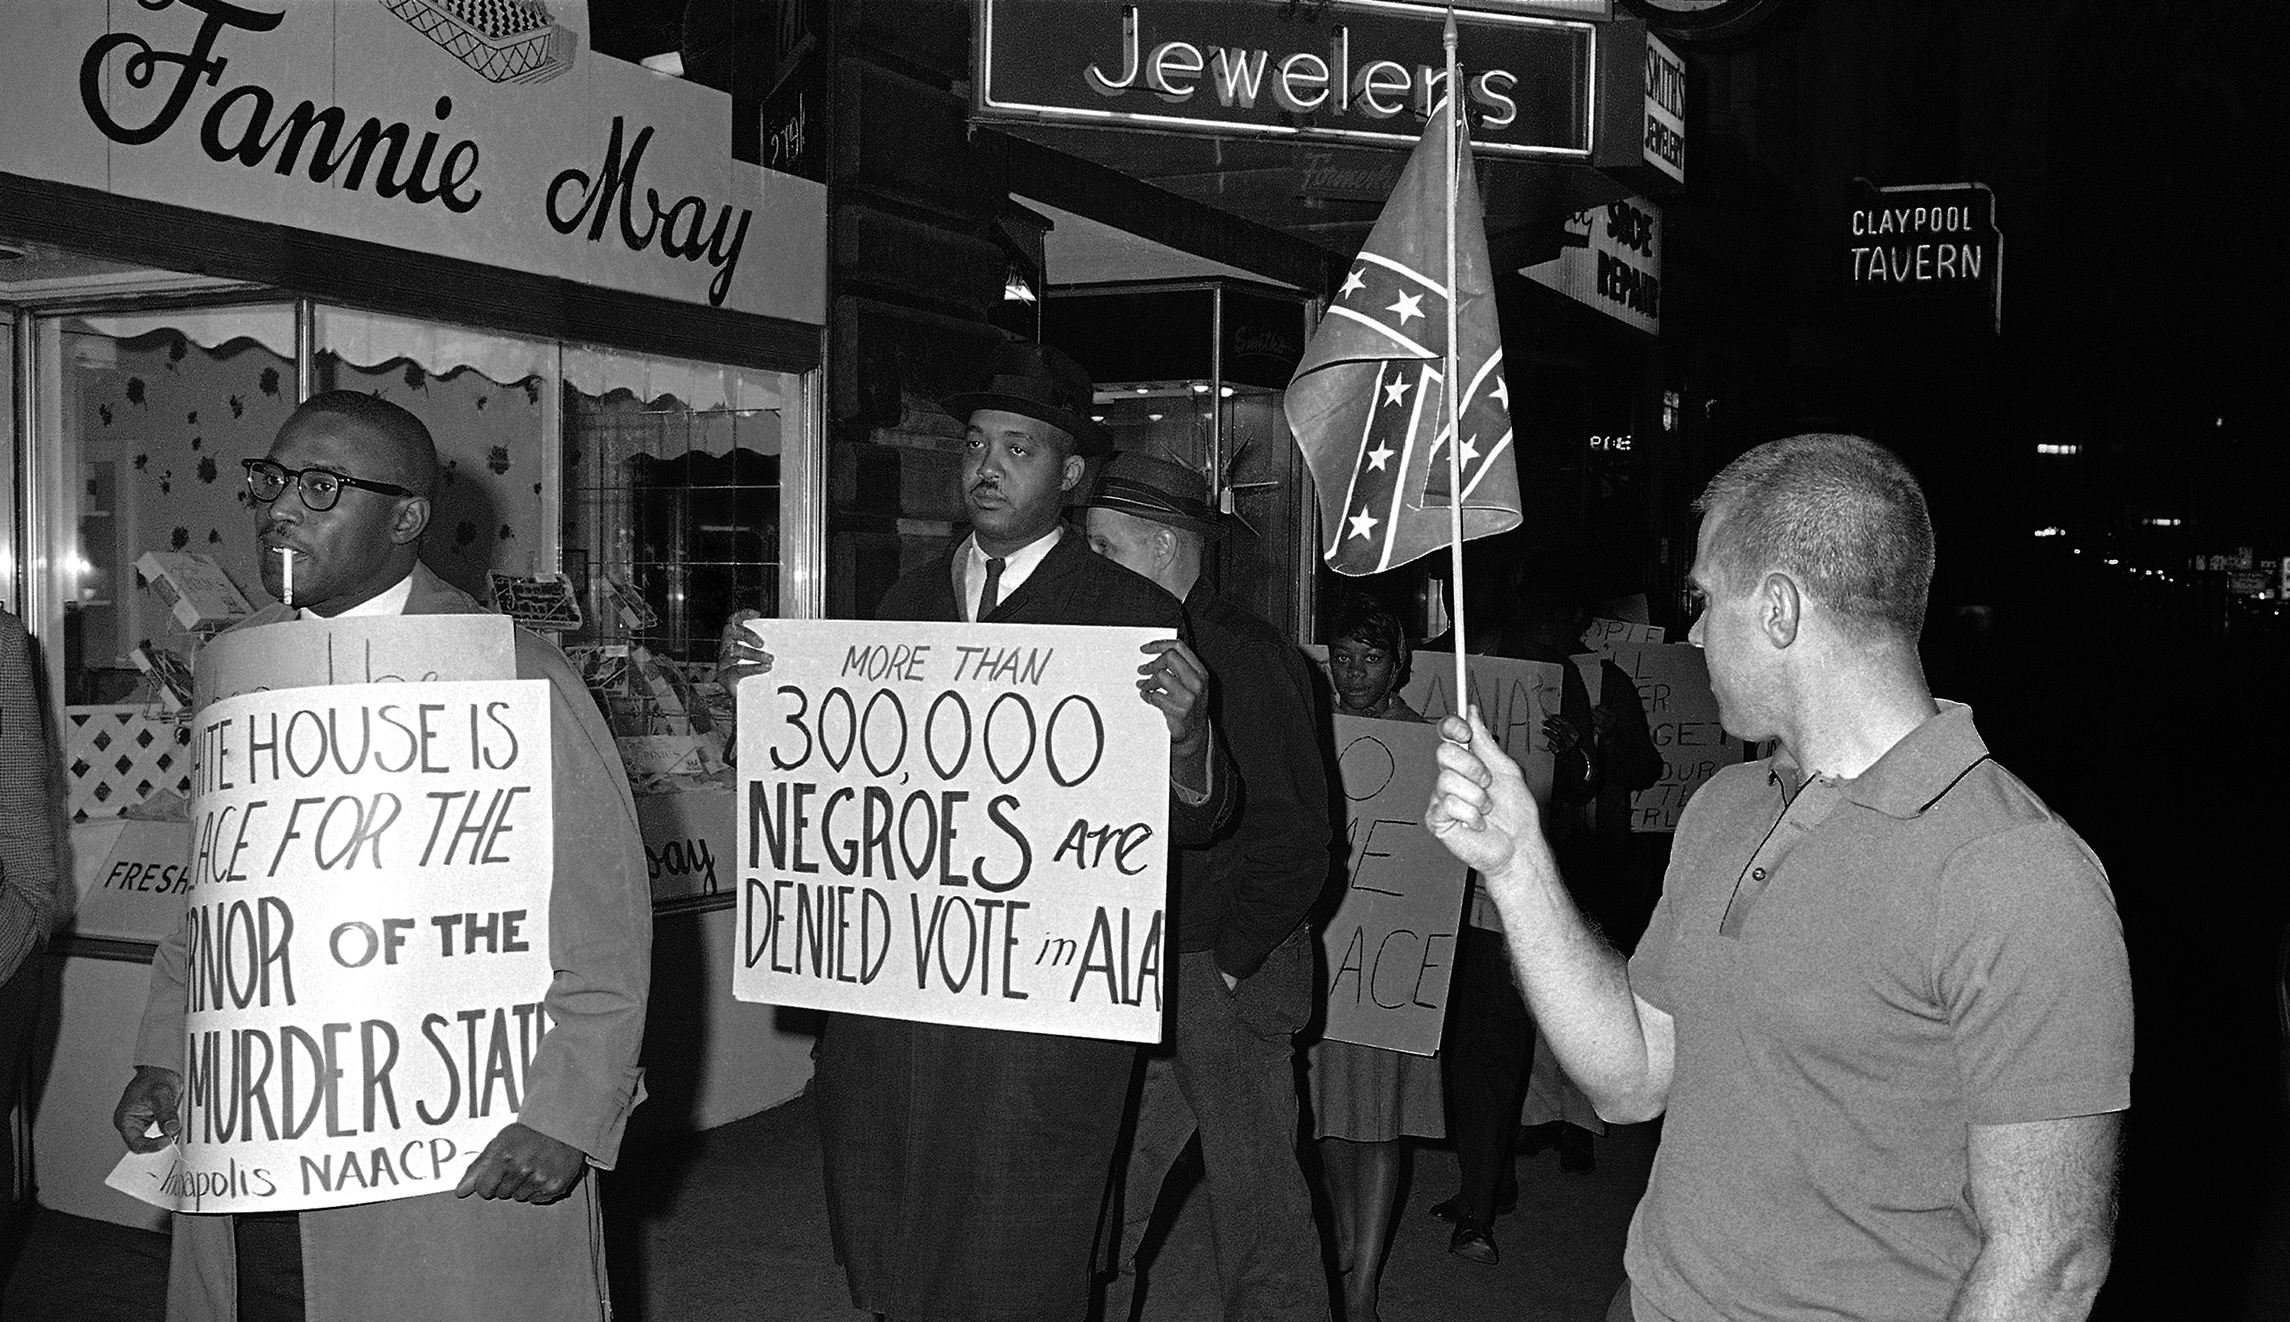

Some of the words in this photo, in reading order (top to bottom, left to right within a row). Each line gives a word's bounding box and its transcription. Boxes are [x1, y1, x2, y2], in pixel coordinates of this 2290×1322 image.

[1083, 4, 1520, 130] Jewelers
[1646, 45, 1685, 121] SMITH'S
[80, 0, 481, 212] Fannie
[546, 116, 752, 306] May
[1607, 200, 1653, 257] SHOE
[1850, 242, 1983, 283] TAVERN
[1851, 206, 1974, 235] CLAYPOOL
[840, 644, 931, 682] MORE
[956, 646, 1053, 686] THAN
[249, 703, 449, 784] HOUSE
[470, 701, 519, 771] IS
[769, 685, 1104, 787] 300,000
[267, 791, 402, 878] FOR
[418, 785, 531, 867] THE
[748, 780, 1032, 893] NEGROES
[104, 861, 189, 895] FRESH
[184, 896, 296, 1014] RNOR
[328, 917, 416, 969] OF
[431, 908, 529, 958] THE
[744, 877, 892, 984] DENIED
[910, 892, 1031, 999] VOTE
[1035, 931, 1078, 967] in
[1070, 905, 1164, 1013] ALA
[1329, 926, 1453, 1010] ACE
[186, 1018, 401, 1144] MURDER
